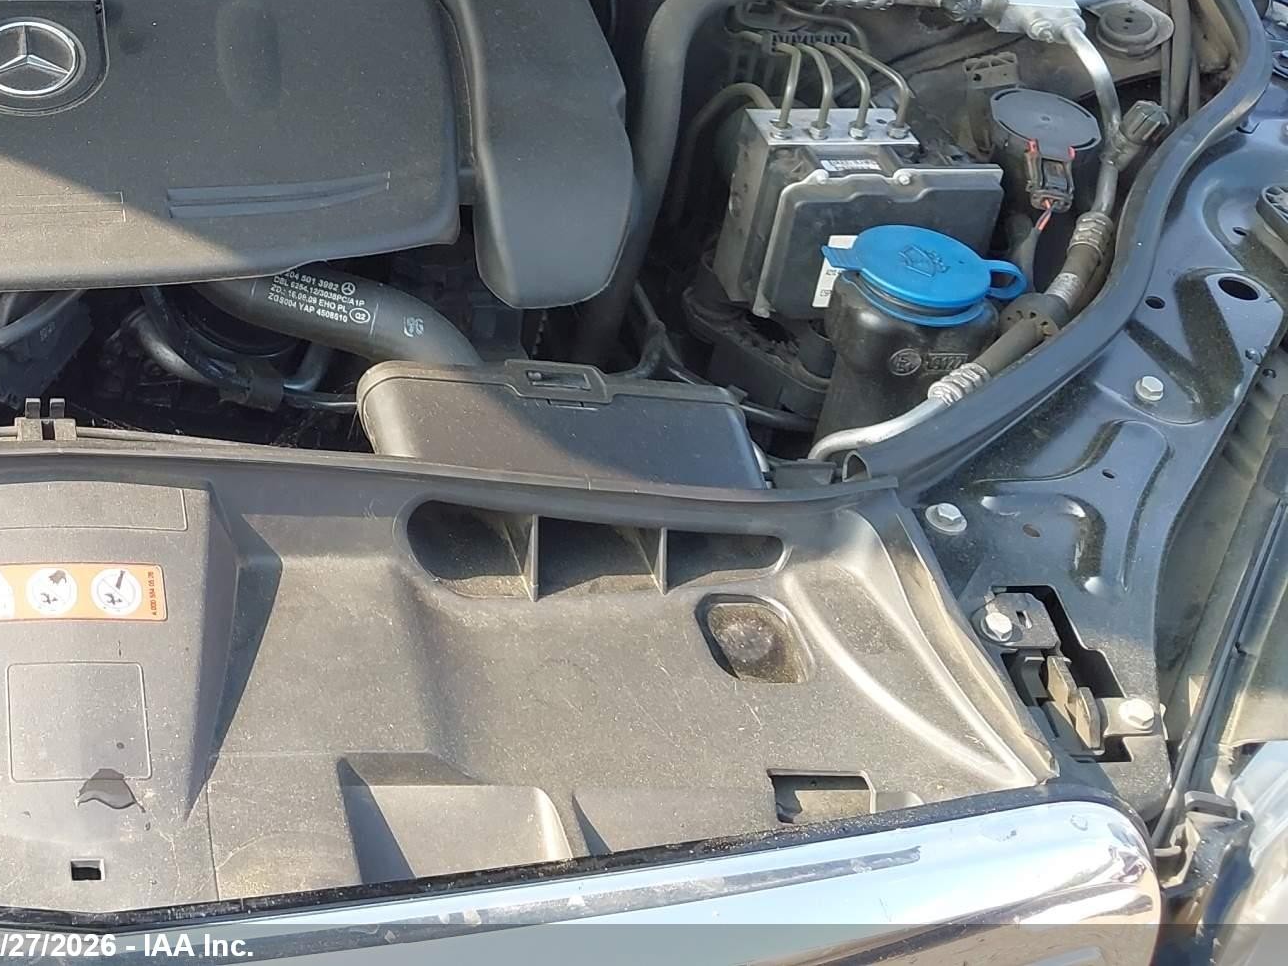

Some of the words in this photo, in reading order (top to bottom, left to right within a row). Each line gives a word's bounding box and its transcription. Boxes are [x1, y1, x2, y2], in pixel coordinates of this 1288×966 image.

[301, 275, 317, 286] 501
[298, 302, 315, 315] YAP
[318, 297, 337, 311] EHO
[337, 303, 349, 315] PL
